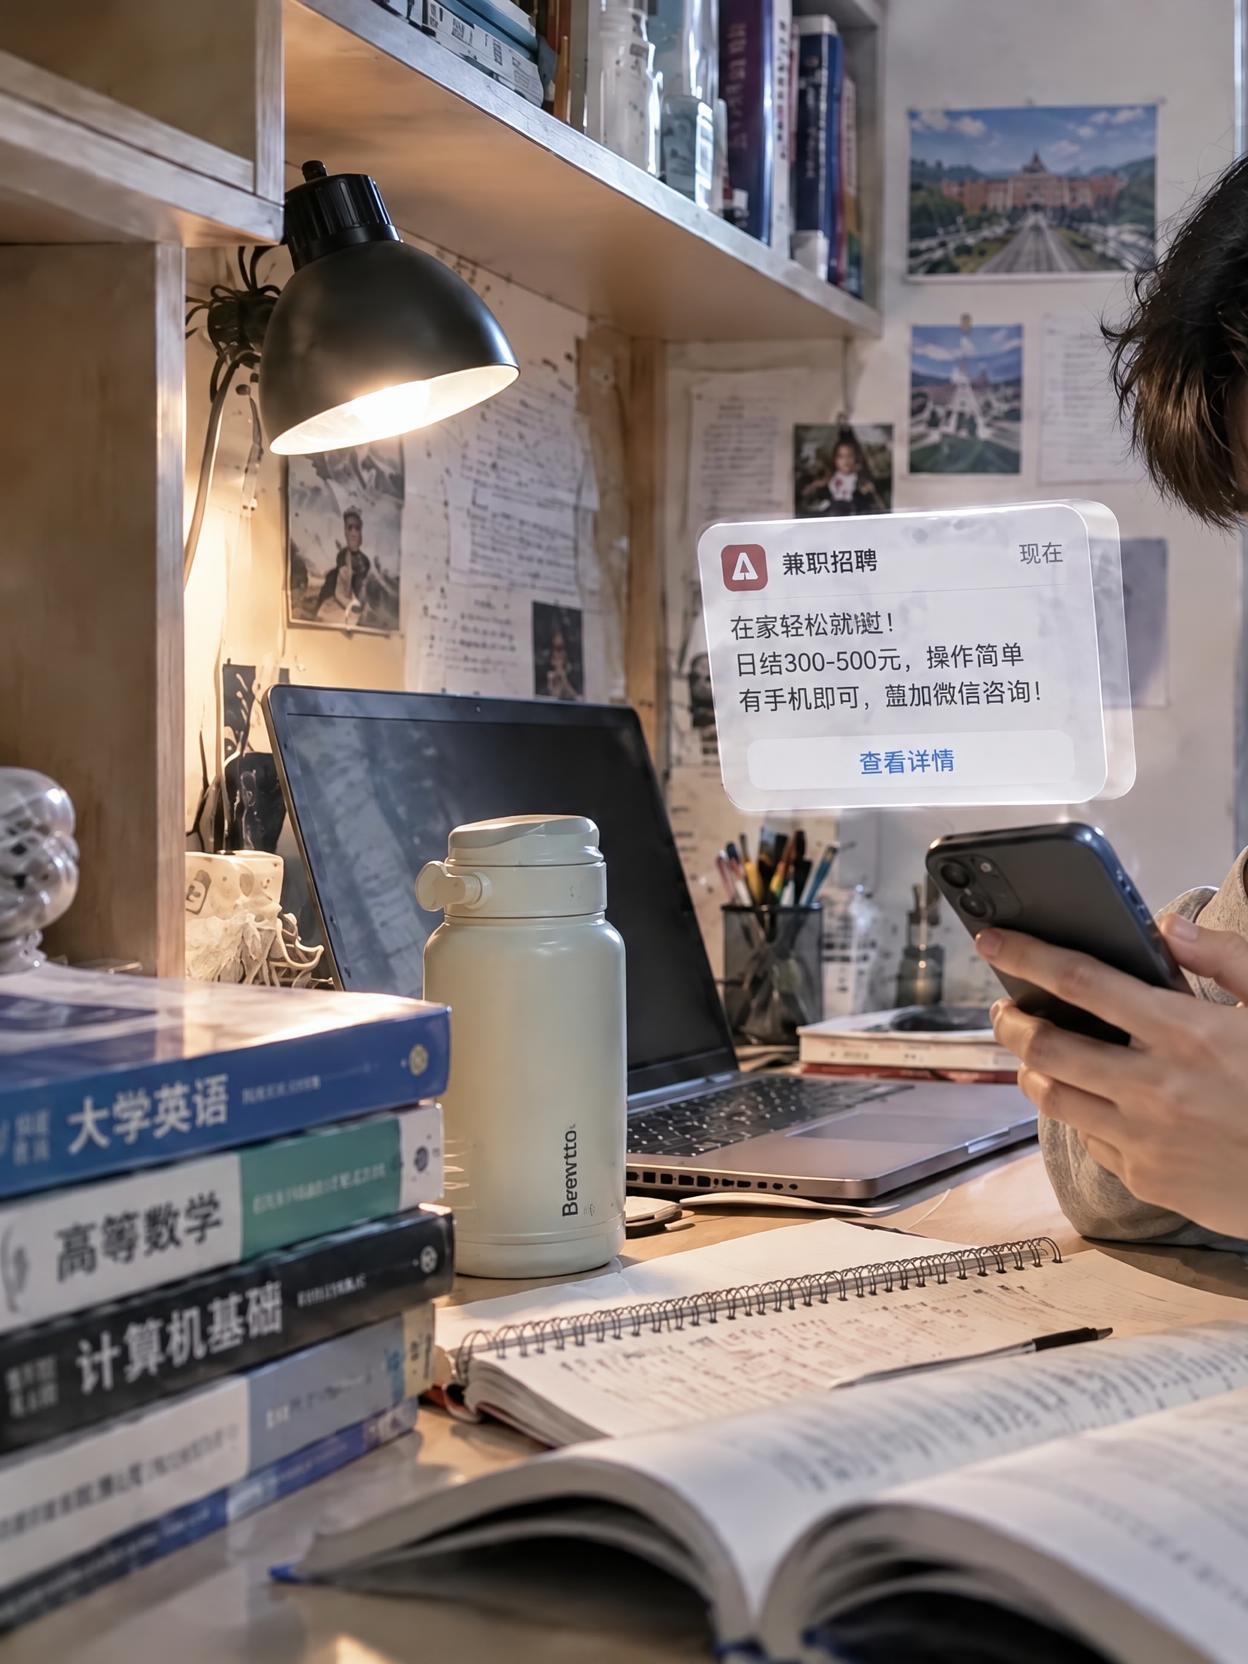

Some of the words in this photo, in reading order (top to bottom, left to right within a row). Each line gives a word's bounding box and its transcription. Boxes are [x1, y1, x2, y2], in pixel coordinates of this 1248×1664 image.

[782, 548, 878, 576] 兼职招聘
[1019, 541, 1064, 565] 现在
[859, 749, 955, 775] 查看详情
[67, 1074, 229, 1156] 大学英语
[56, 1192, 221, 1283] 高等数学
[76, 1281, 283, 1394] 计算机基础
